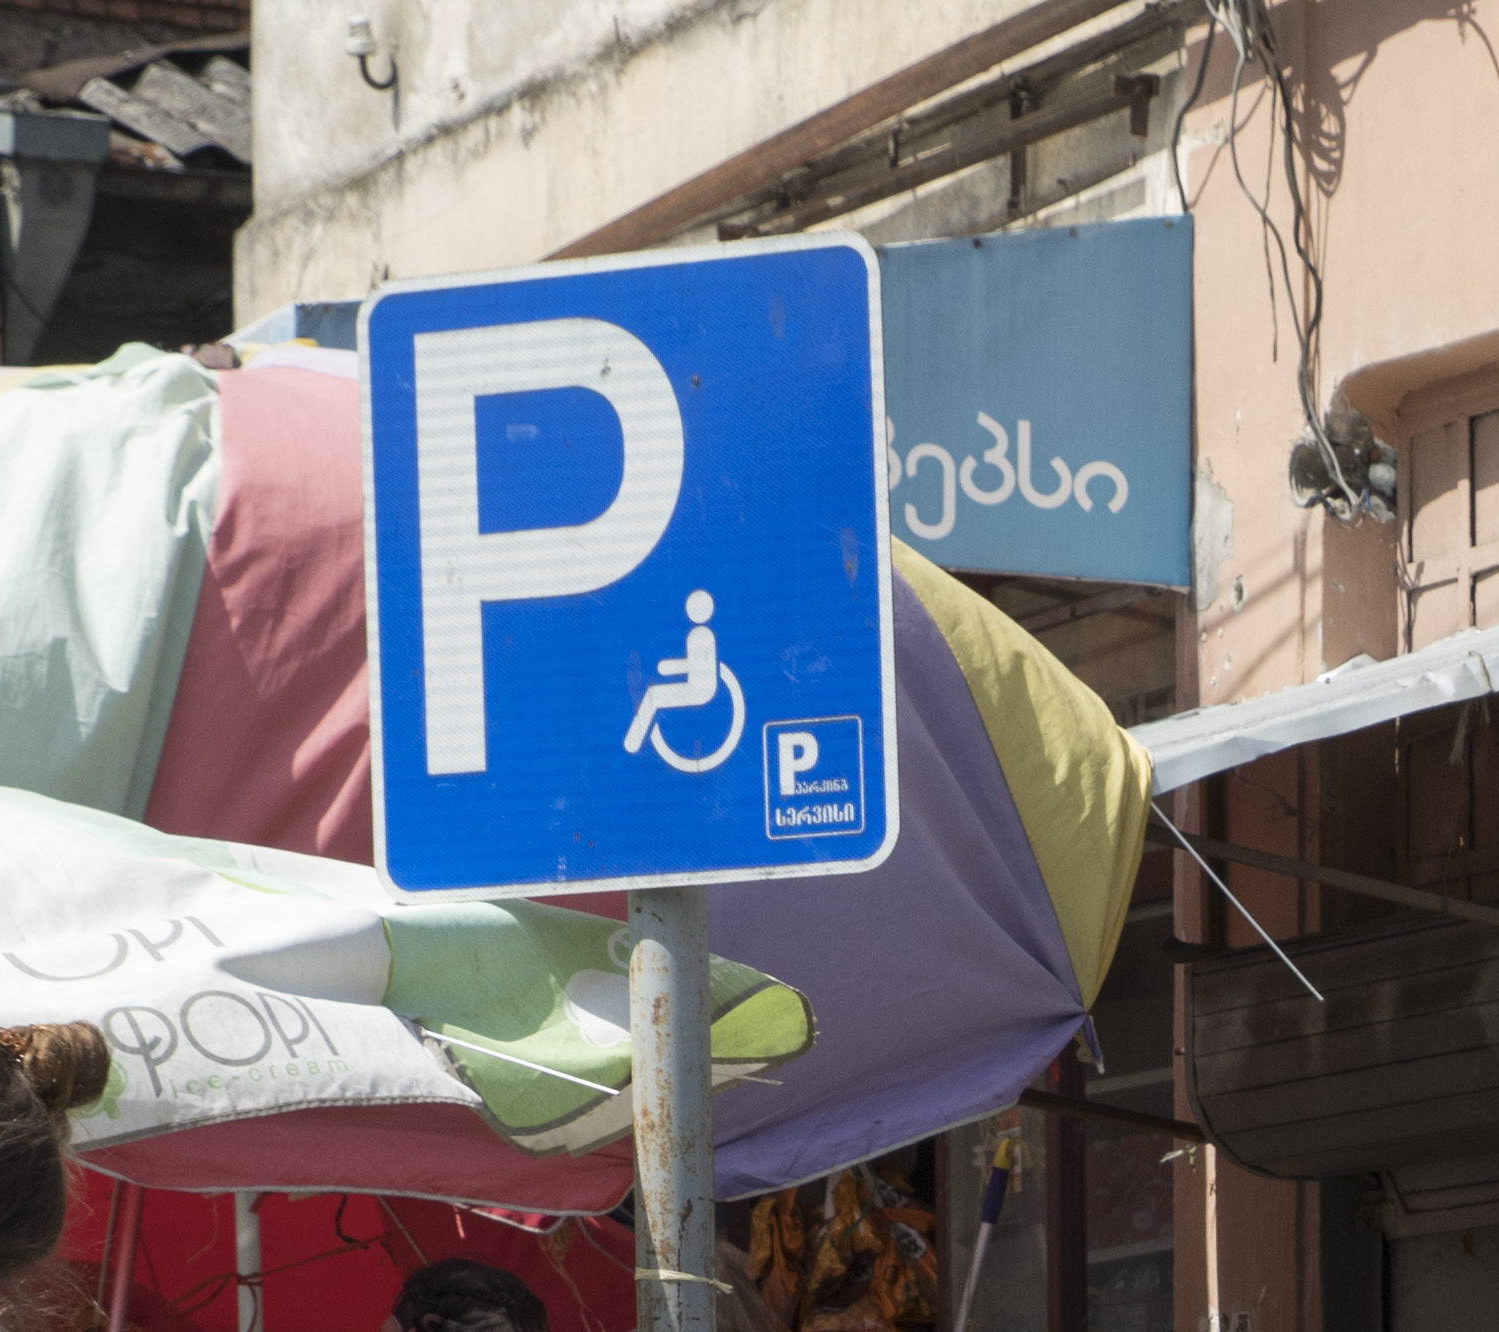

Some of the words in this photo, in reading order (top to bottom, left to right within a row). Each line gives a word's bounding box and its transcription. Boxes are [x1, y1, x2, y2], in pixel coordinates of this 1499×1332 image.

[887, 411, 1129, 540] ეპსი
[414, 317, 685, 777] P
[778, 732, 818, 795] P
[775, 803, 854, 827] სერვისი
[169, 1057, 350, 1099] ice-cream
